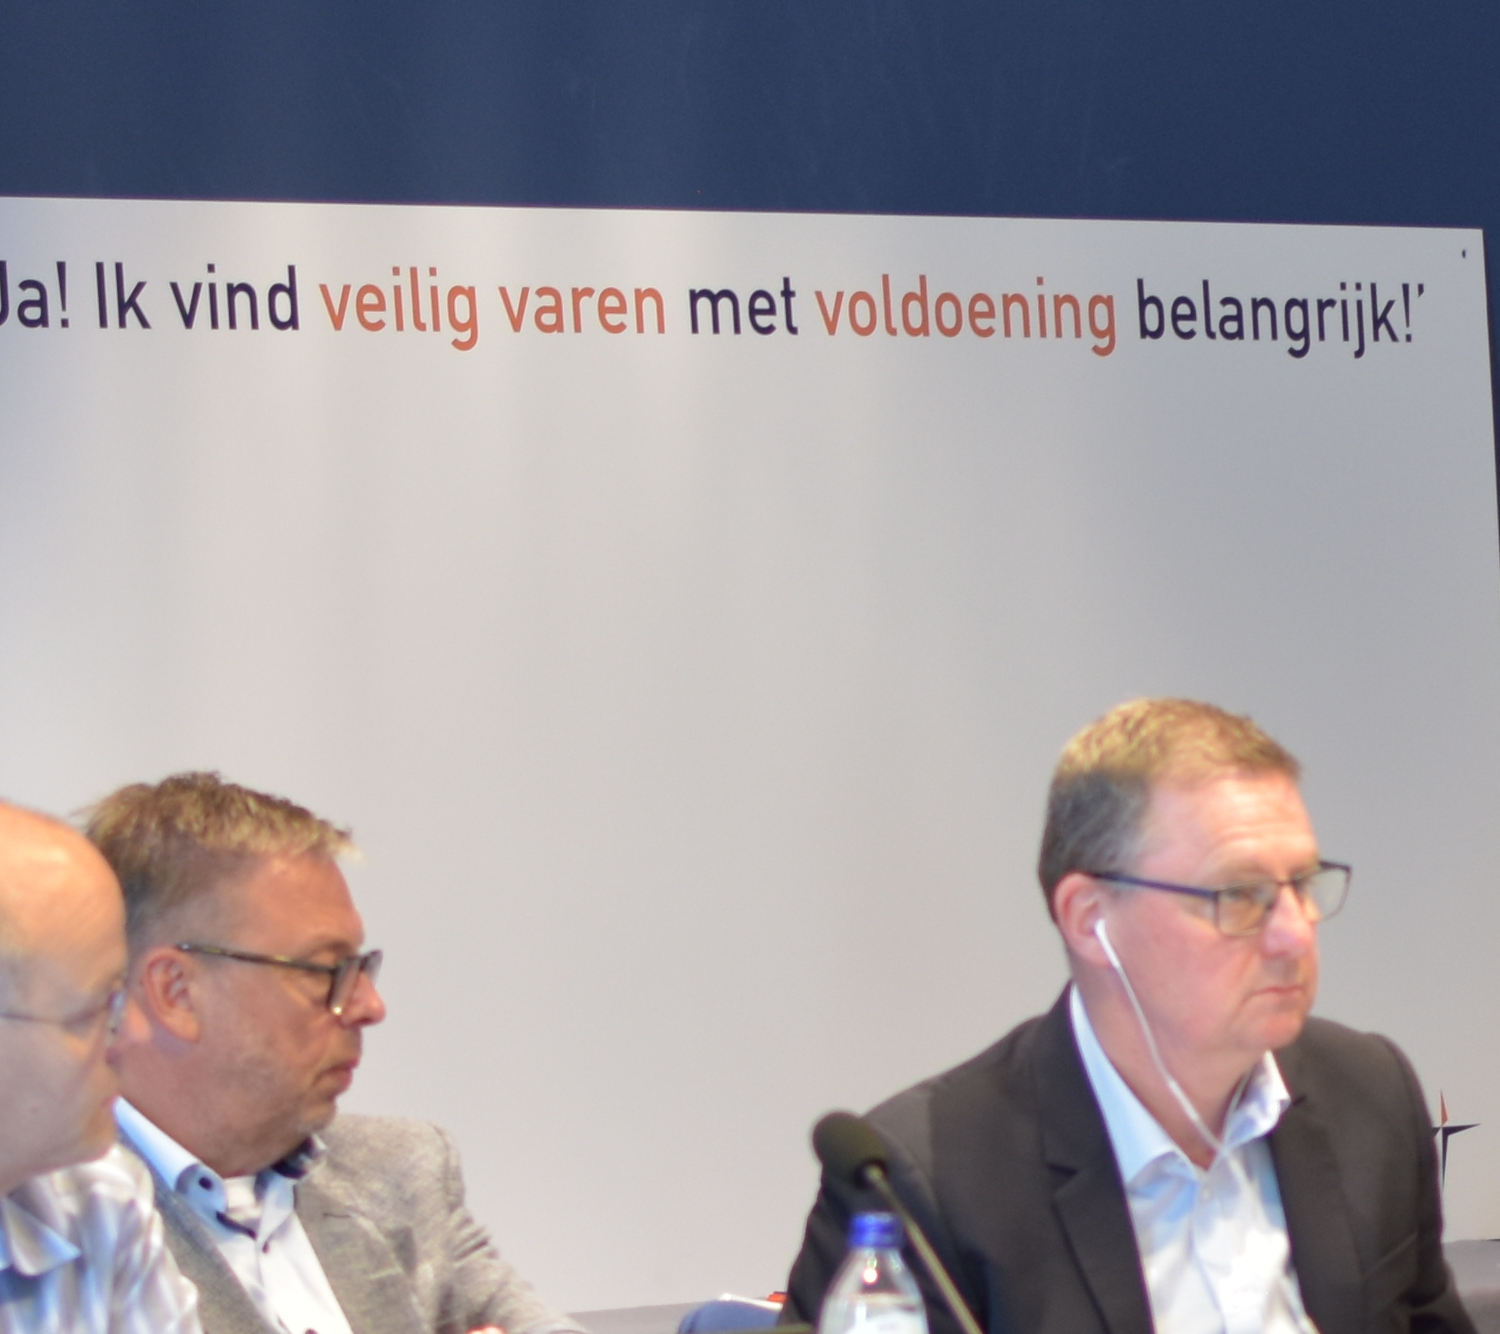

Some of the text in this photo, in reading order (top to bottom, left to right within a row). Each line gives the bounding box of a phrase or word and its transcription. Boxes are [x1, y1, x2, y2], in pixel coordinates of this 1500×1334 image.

[95, 261, 151, 330] Ik
[169, 263, 300, 331] vind
[319, 266, 480, 352] veilig
[499, 286, 667, 335] varen
[688, 277, 799, 336] met
[814, 274, 1117, 357] voldoening
